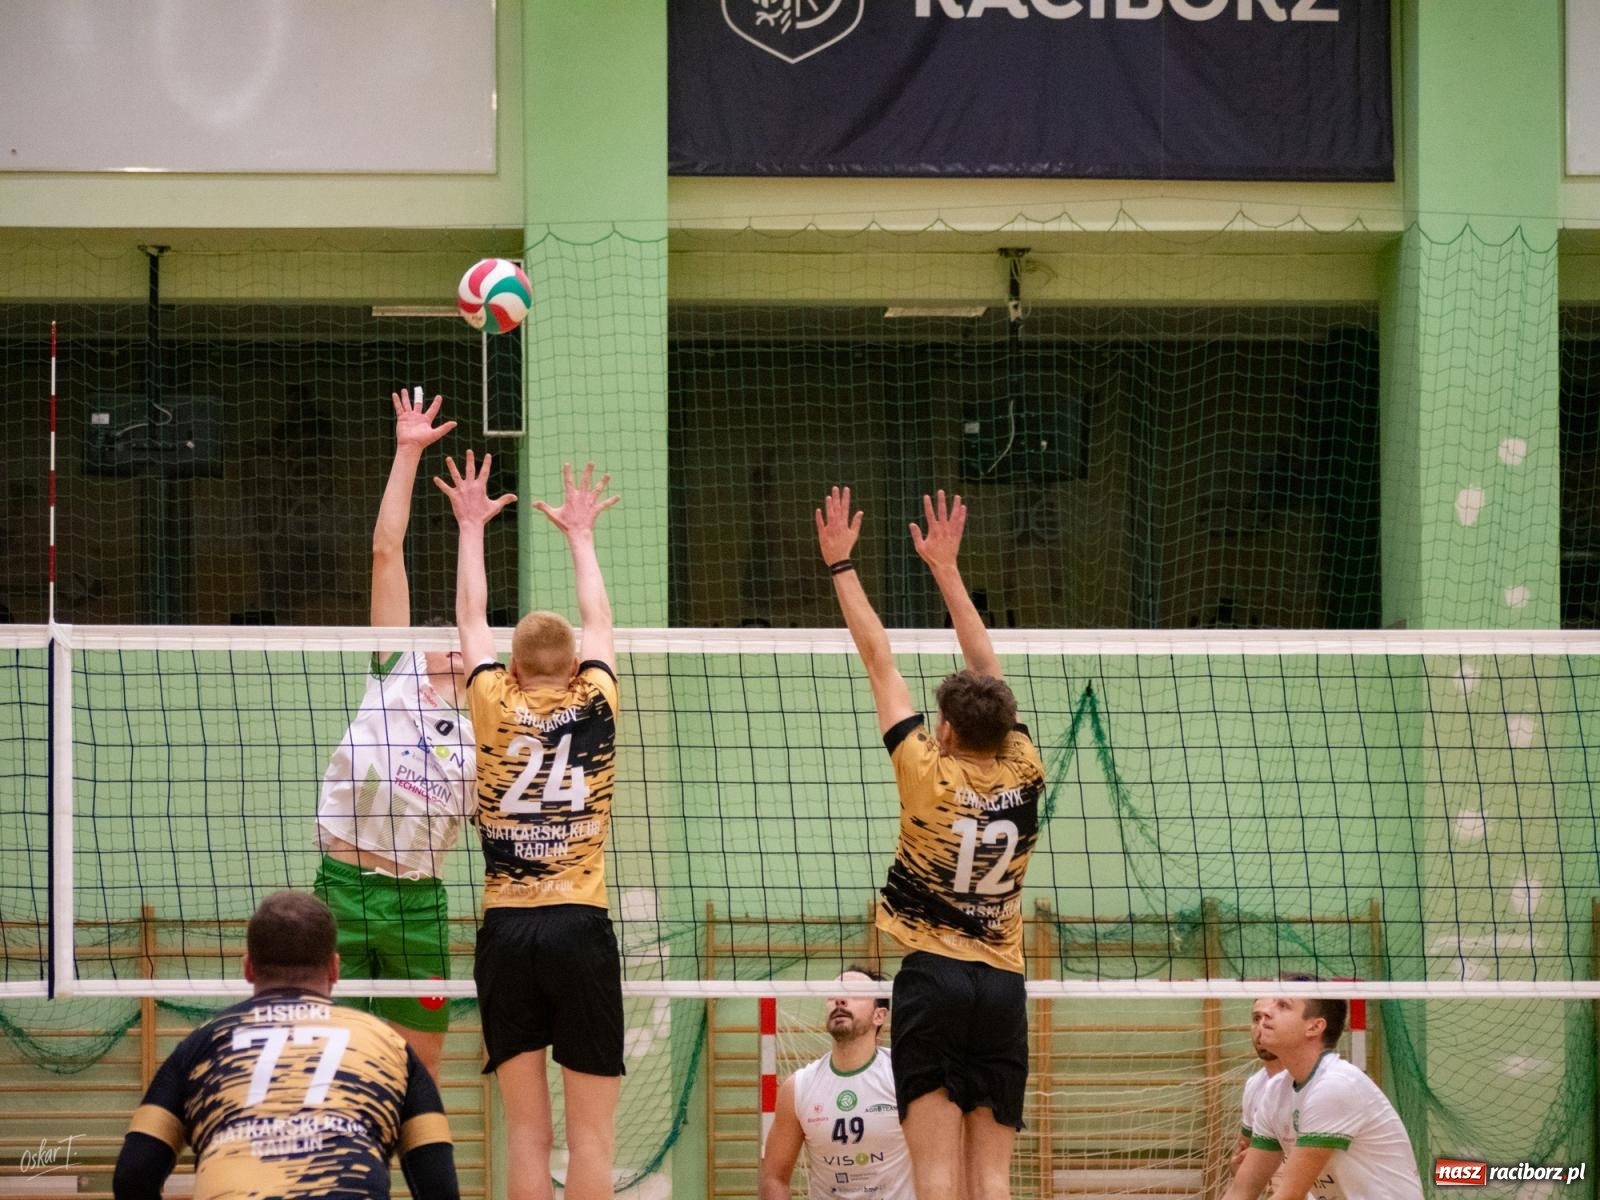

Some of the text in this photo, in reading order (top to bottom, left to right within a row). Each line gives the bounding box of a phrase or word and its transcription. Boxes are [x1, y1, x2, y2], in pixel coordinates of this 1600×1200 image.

[396, 764, 452, 803] PIVEXIN
[500, 733, 590, 814] 24
[514, 841, 568, 858] RADLIN
[952, 818, 1019, 896] 12
[232, 1026, 350, 1108] 77
[831, 1116, 865, 1144] 49
